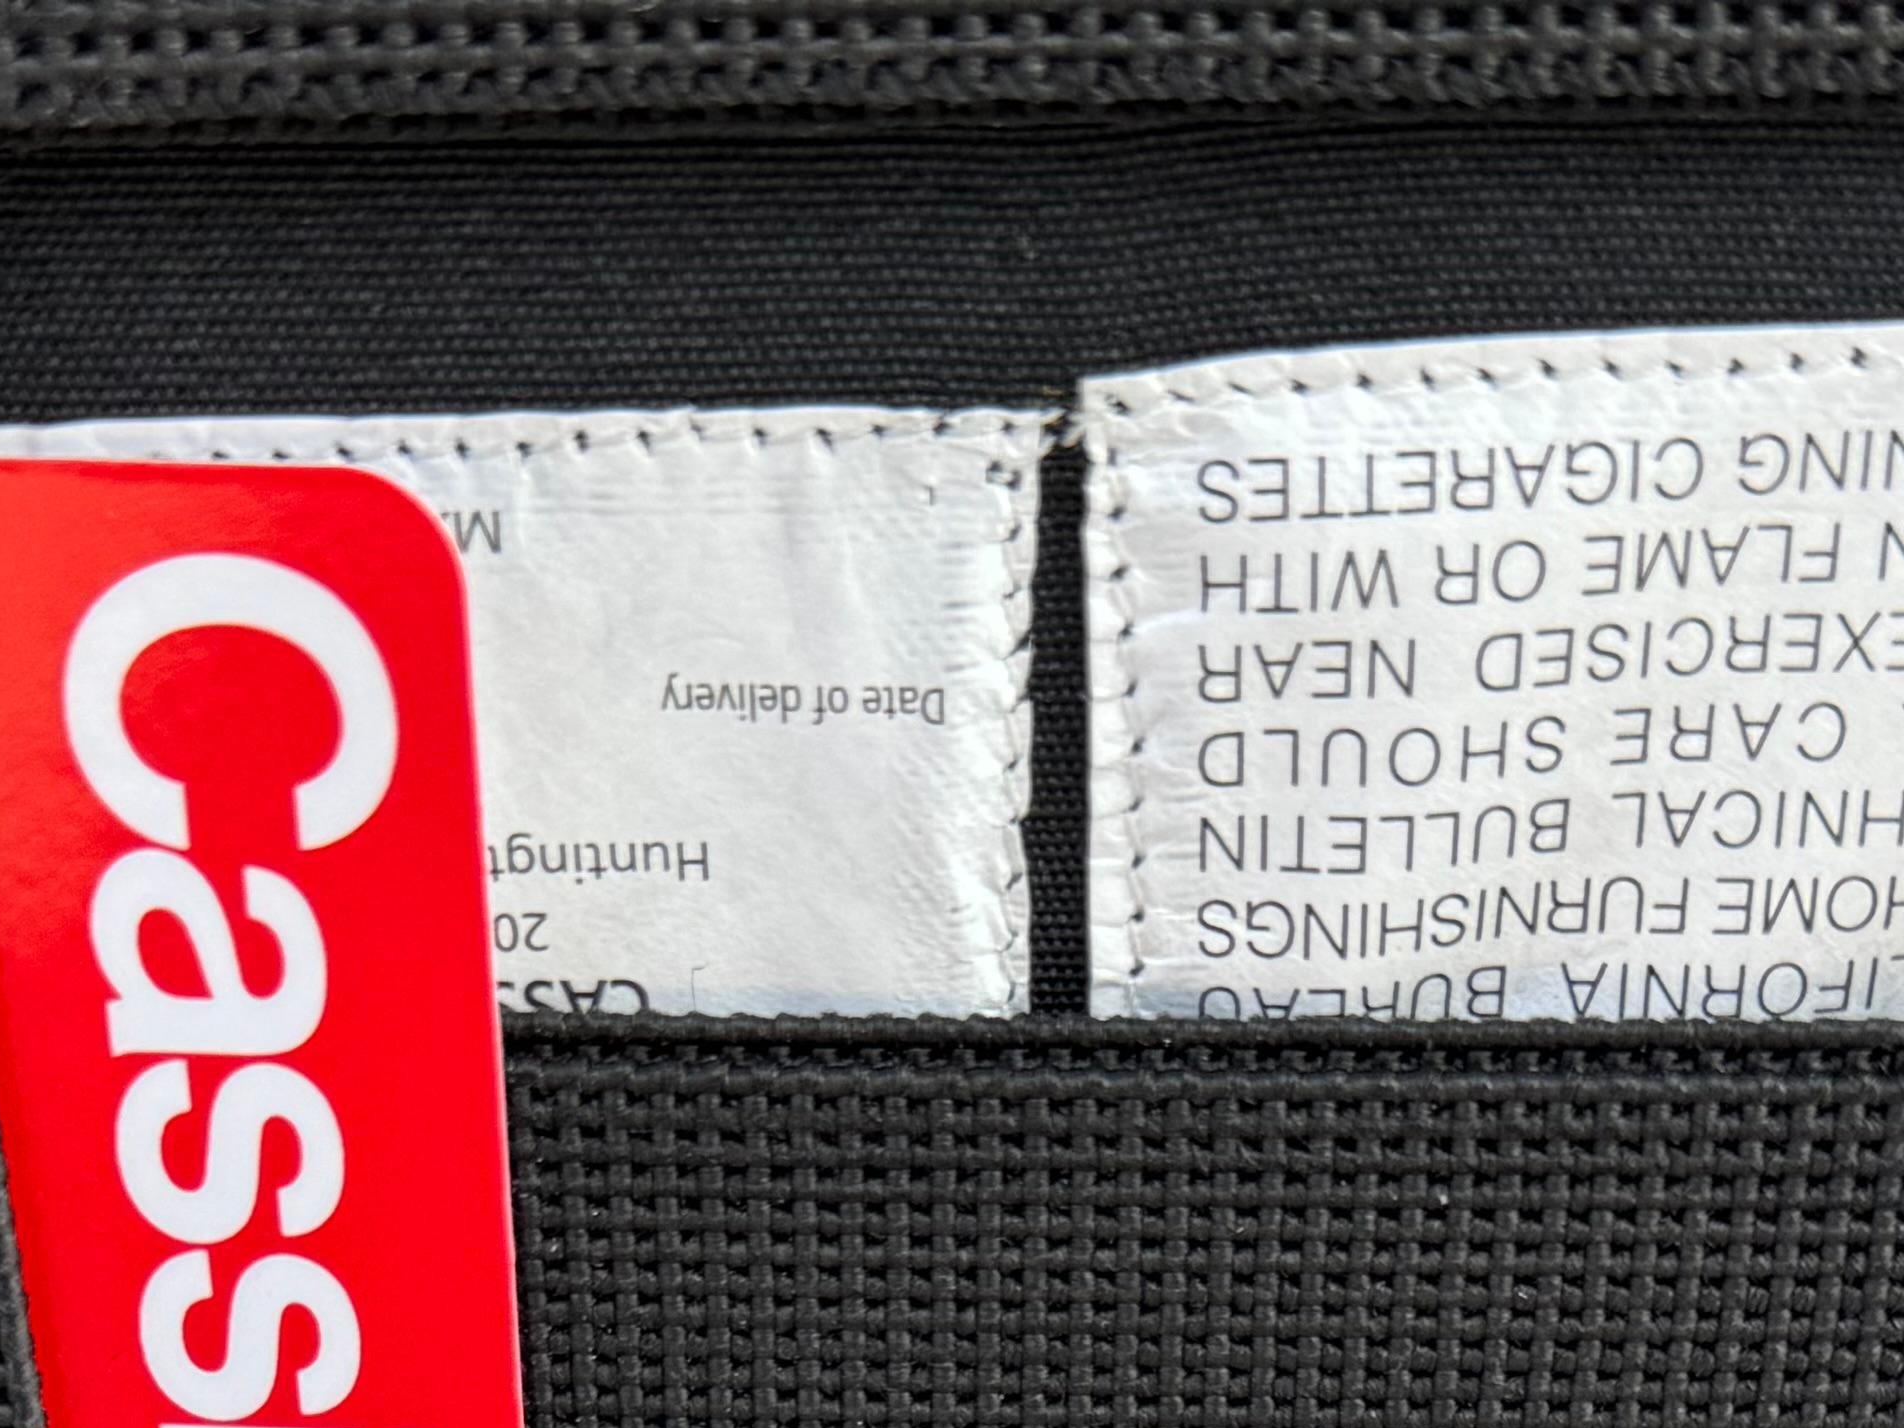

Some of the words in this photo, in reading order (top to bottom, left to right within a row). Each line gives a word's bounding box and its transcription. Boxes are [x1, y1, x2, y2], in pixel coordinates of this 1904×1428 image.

[1198, 438, 1704, 523] CIGARETTES
[440, 511, 502, 553] M
[1582, 523, 1840, 595] FLAME
[1201, 548, 1398, 612] WITH
[1435, 541, 1546, 604] OR
[661, 673, 801, 722] delivery
[1198, 637, 1416, 701] NEAR
[812, 686, 849, 724] of
[862, 685, 946, 725] Date
[1611, 703, 1845, 763] CARE
[1199, 717, 1564, 787] SHOULD
[1199, 798, 1569, 871] BULLETIN
[1196, 879, 1688, 958] FURNISHINGS
[496, 978, 649, 1013] CAS
